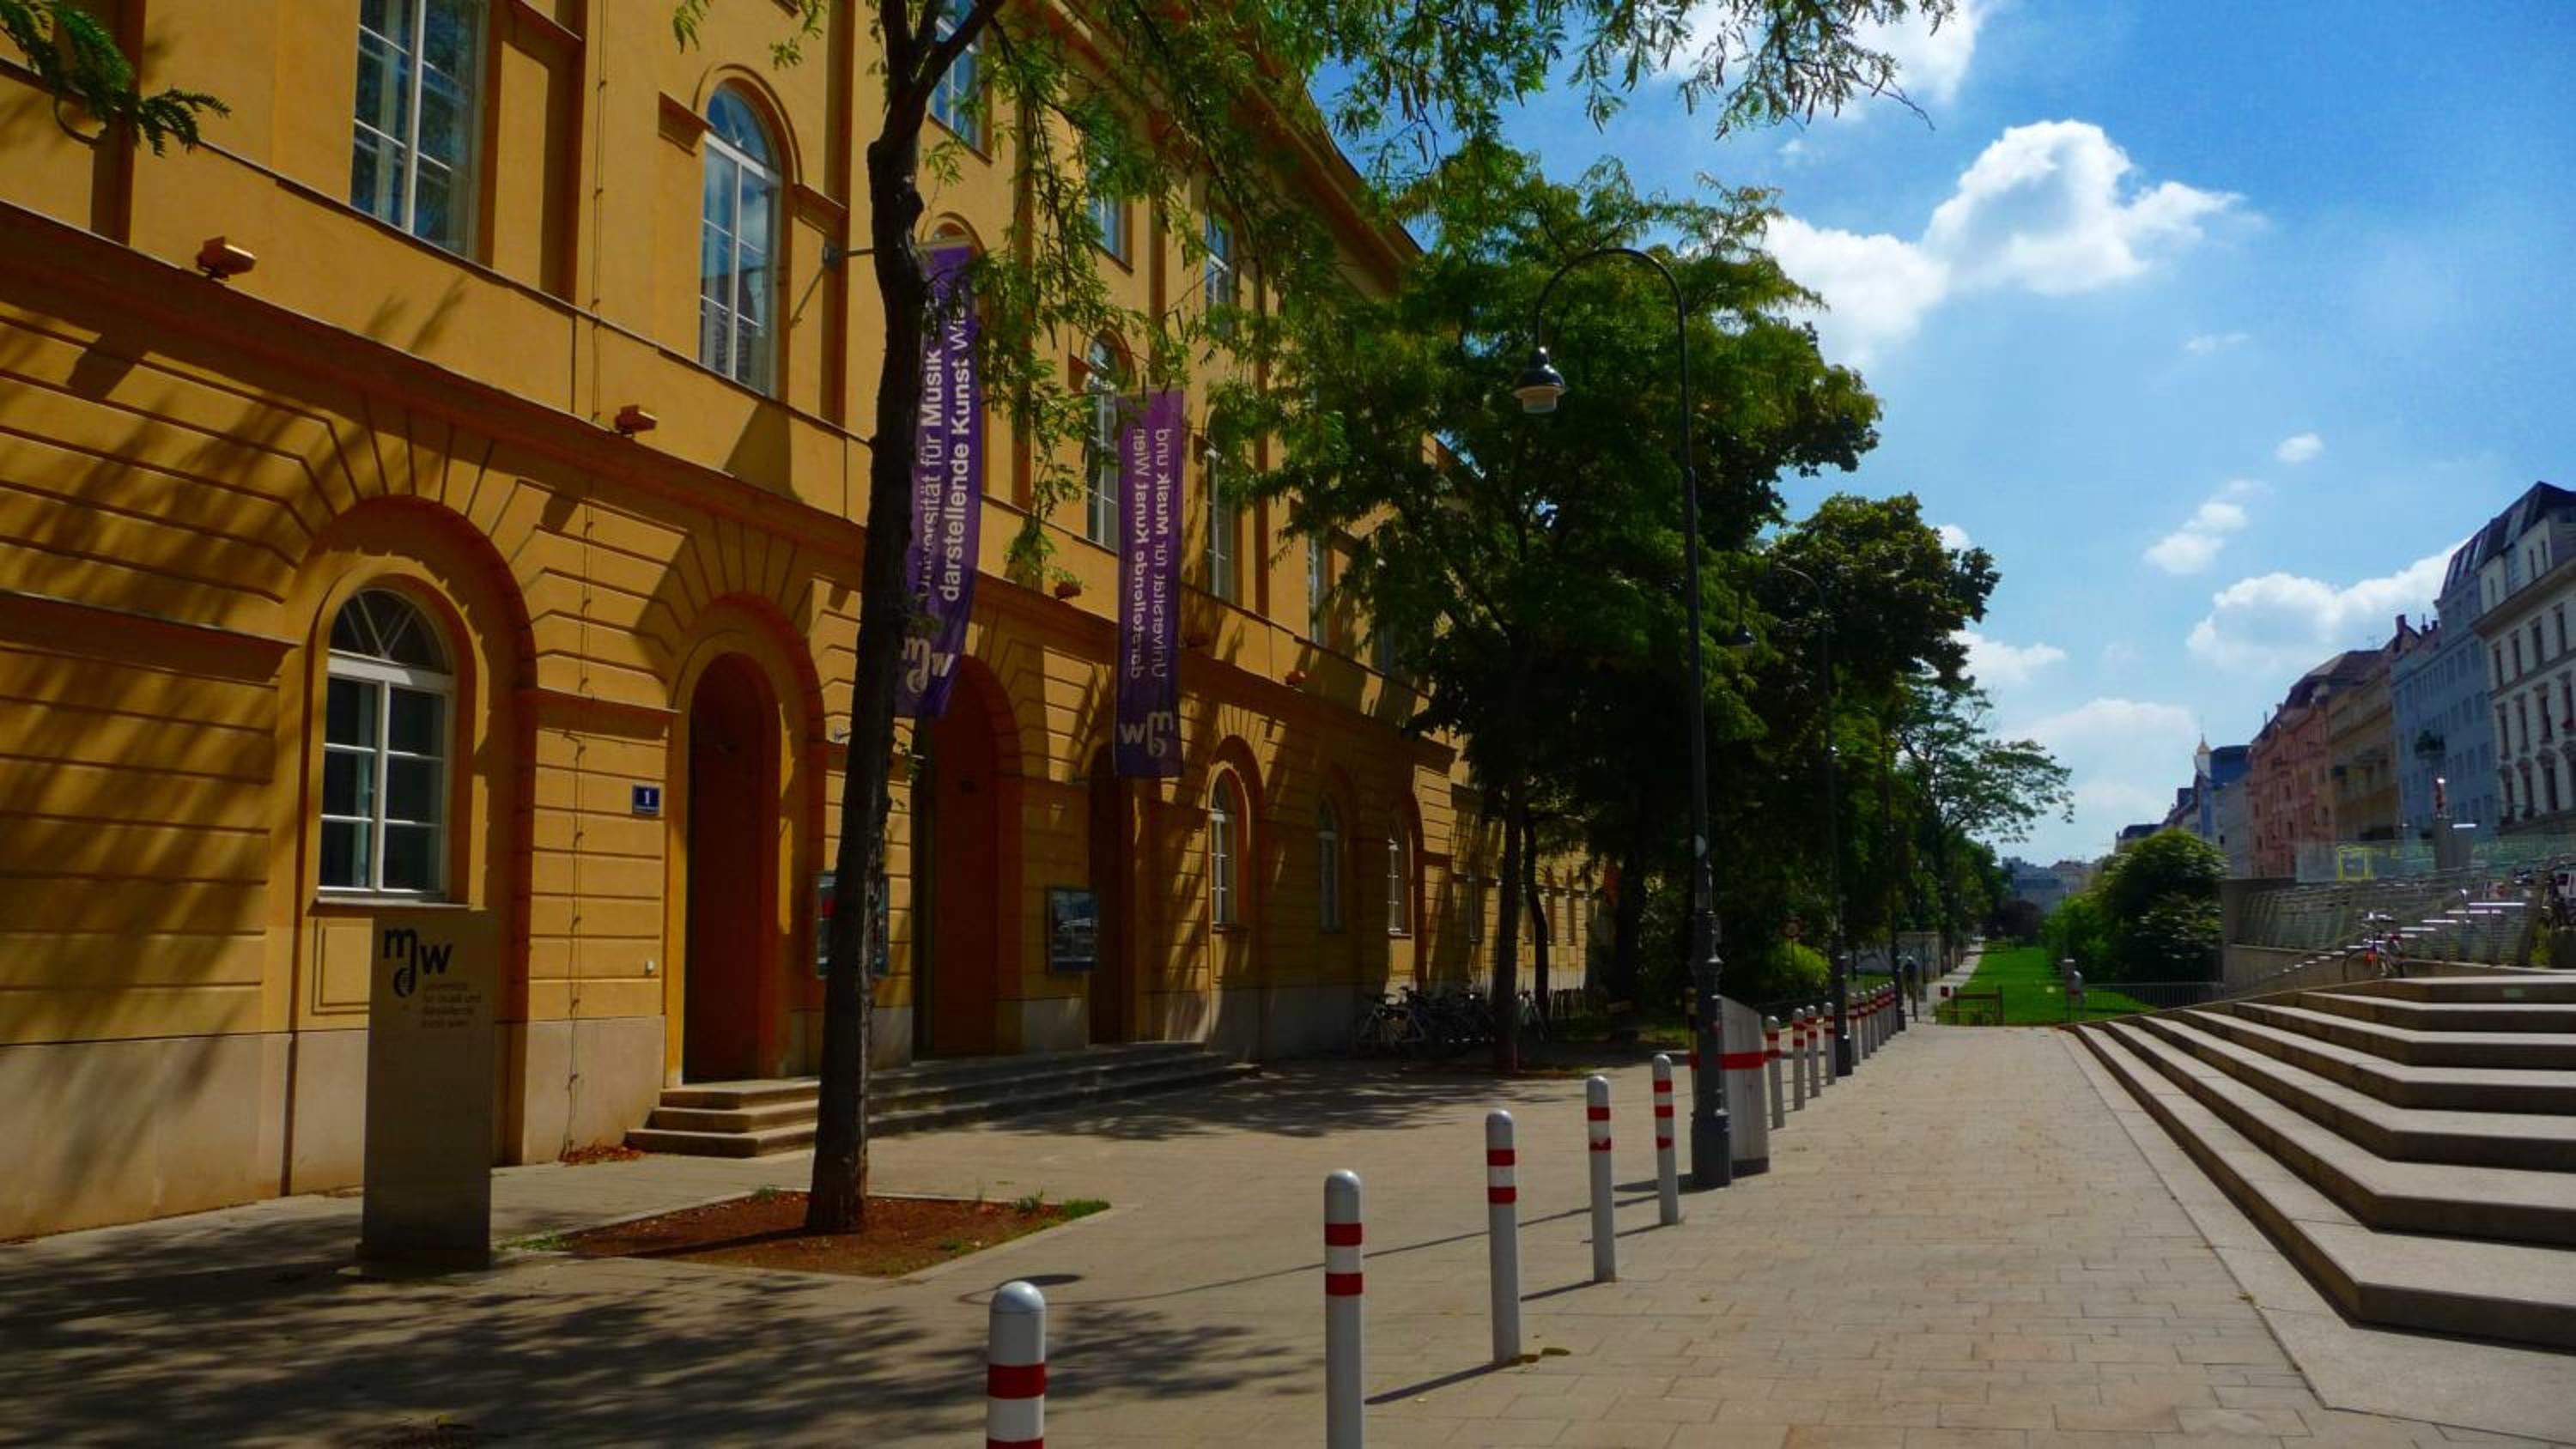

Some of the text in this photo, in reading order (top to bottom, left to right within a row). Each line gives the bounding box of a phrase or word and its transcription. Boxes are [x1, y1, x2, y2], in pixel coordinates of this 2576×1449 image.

[920, 349, 942, 427] Musik
[951, 358, 970, 435] Kunst
[920, 434, 942, 466] für
[939, 443, 970, 602] darstellende
